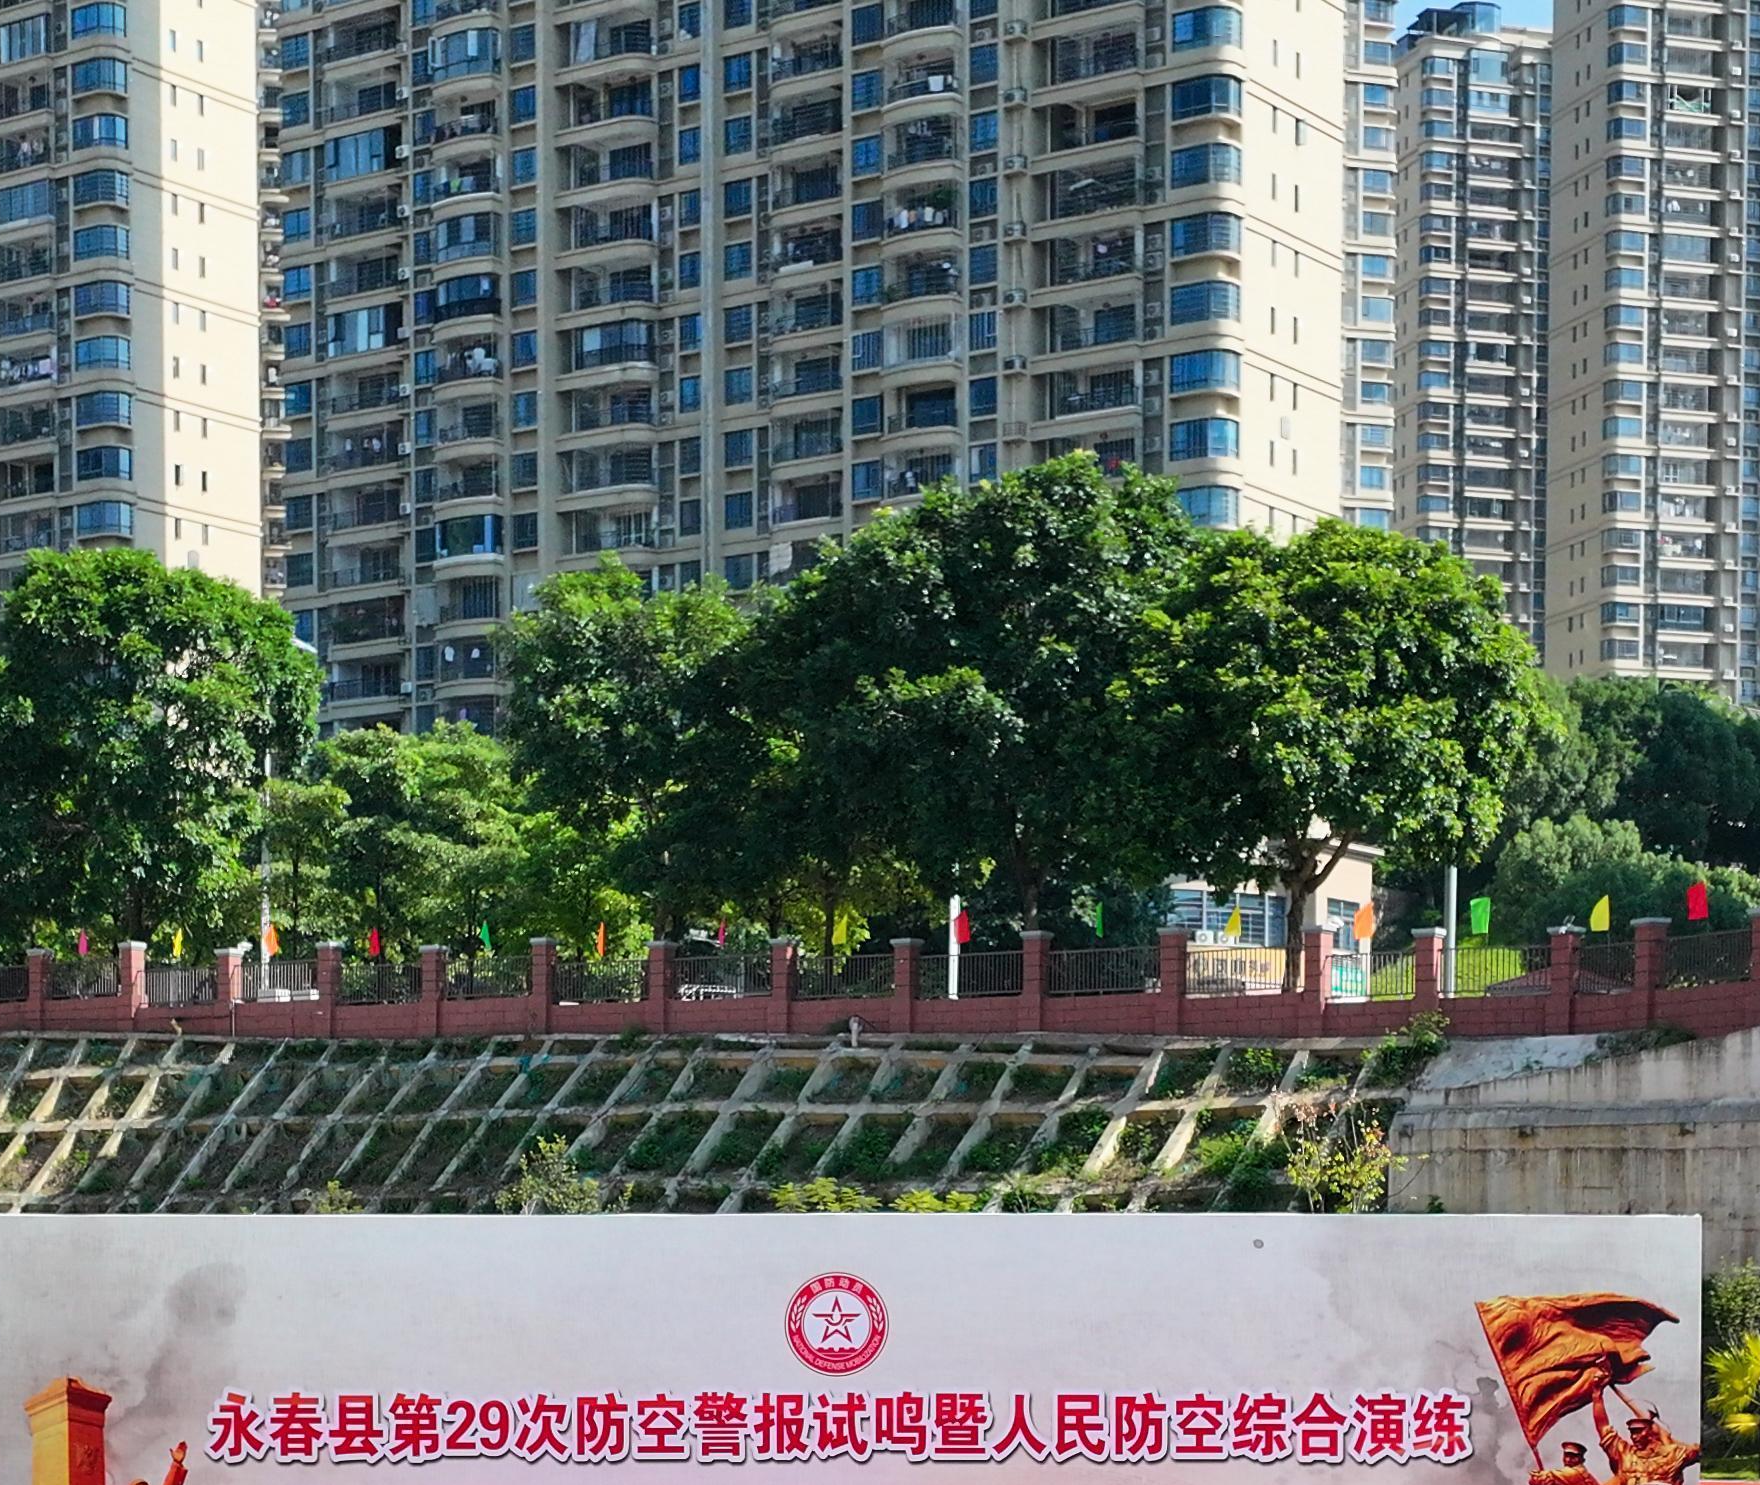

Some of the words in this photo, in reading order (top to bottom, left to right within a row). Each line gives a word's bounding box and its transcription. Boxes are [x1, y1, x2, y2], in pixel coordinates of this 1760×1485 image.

[809, 1277, 864, 1295] 国防动员
[814, 1358, 846, 1371] DEFENSE
[209, 1391, 1468, 1459] 永春县第29次防空警报试鸣暨人民防空综合演练
